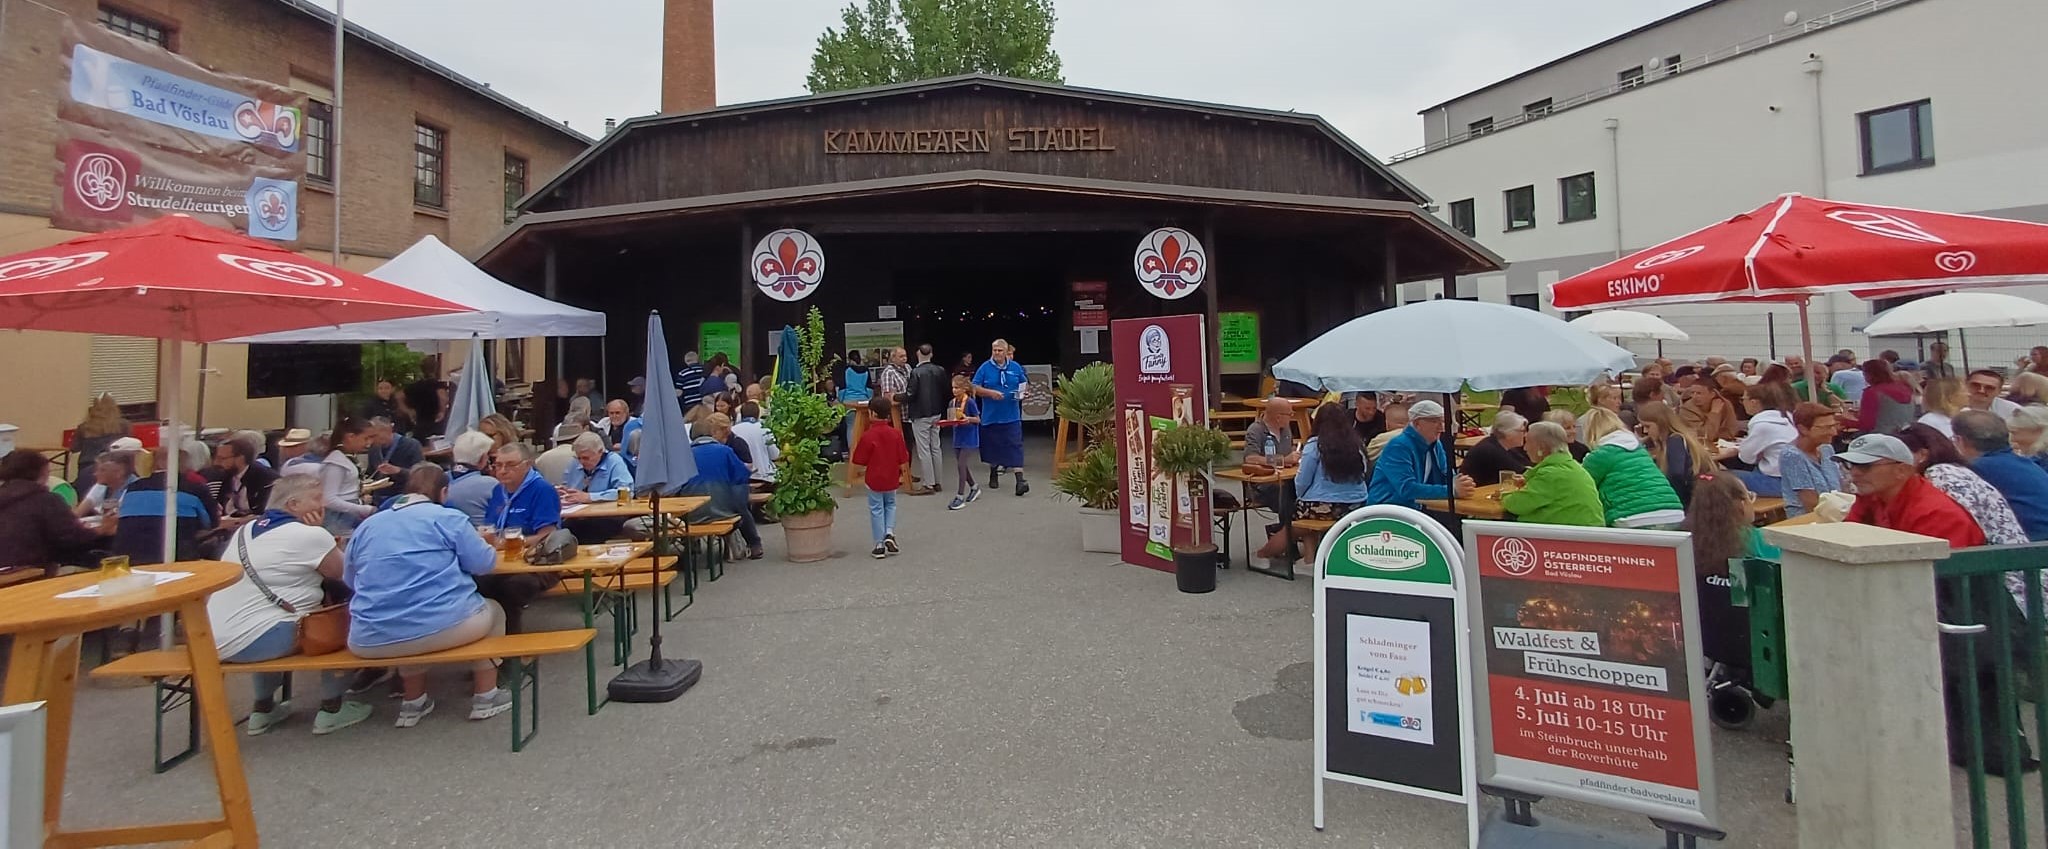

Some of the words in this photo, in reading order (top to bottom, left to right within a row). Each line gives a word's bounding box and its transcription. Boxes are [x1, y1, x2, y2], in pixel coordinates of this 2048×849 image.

[131, 89, 168, 115] Bad
[170, 101, 230, 131] Vöslau
[824, 128, 990, 154] KAMMGARN
[1008, 127, 1116, 152] STADEL
[134, 174, 221, 197] Willkommen
[1354, 544, 1420, 560] Schladminger
[1543, 559, 1613, 574] ÖSTERREICH
[1359, 637, 1417, 651] Schladminger
[1496, 631, 1575, 650] Waldfest
[1580, 636, 1596, 651] &
[1527, 655, 1659, 687] Frühschoppen
[1515, 686, 1530, 701] 4.
[1534, 688, 1568, 707] Juli
[1573, 695, 1596, 711] ab
[1601, 699, 1623, 715] 18
[1628, 702, 1667, 722] Uhr
[1516, 705, 1532, 721] 5.
[1535, 708, 1570, 728] Juli
[1575, 715, 1625, 736] 10-15
[1630, 722, 1668, 743] Uhr
[1519, 727, 1535, 739] im
[1537, 730, 1602, 751] Steinbruch
[1605, 743, 1668, 762] unterhalb
[1547, 745, 1567, 757] der
[1571, 750, 1639, 771] Roverhütte
[1580, 777, 1696, 807] pfadfinder-badvoeslau.at
